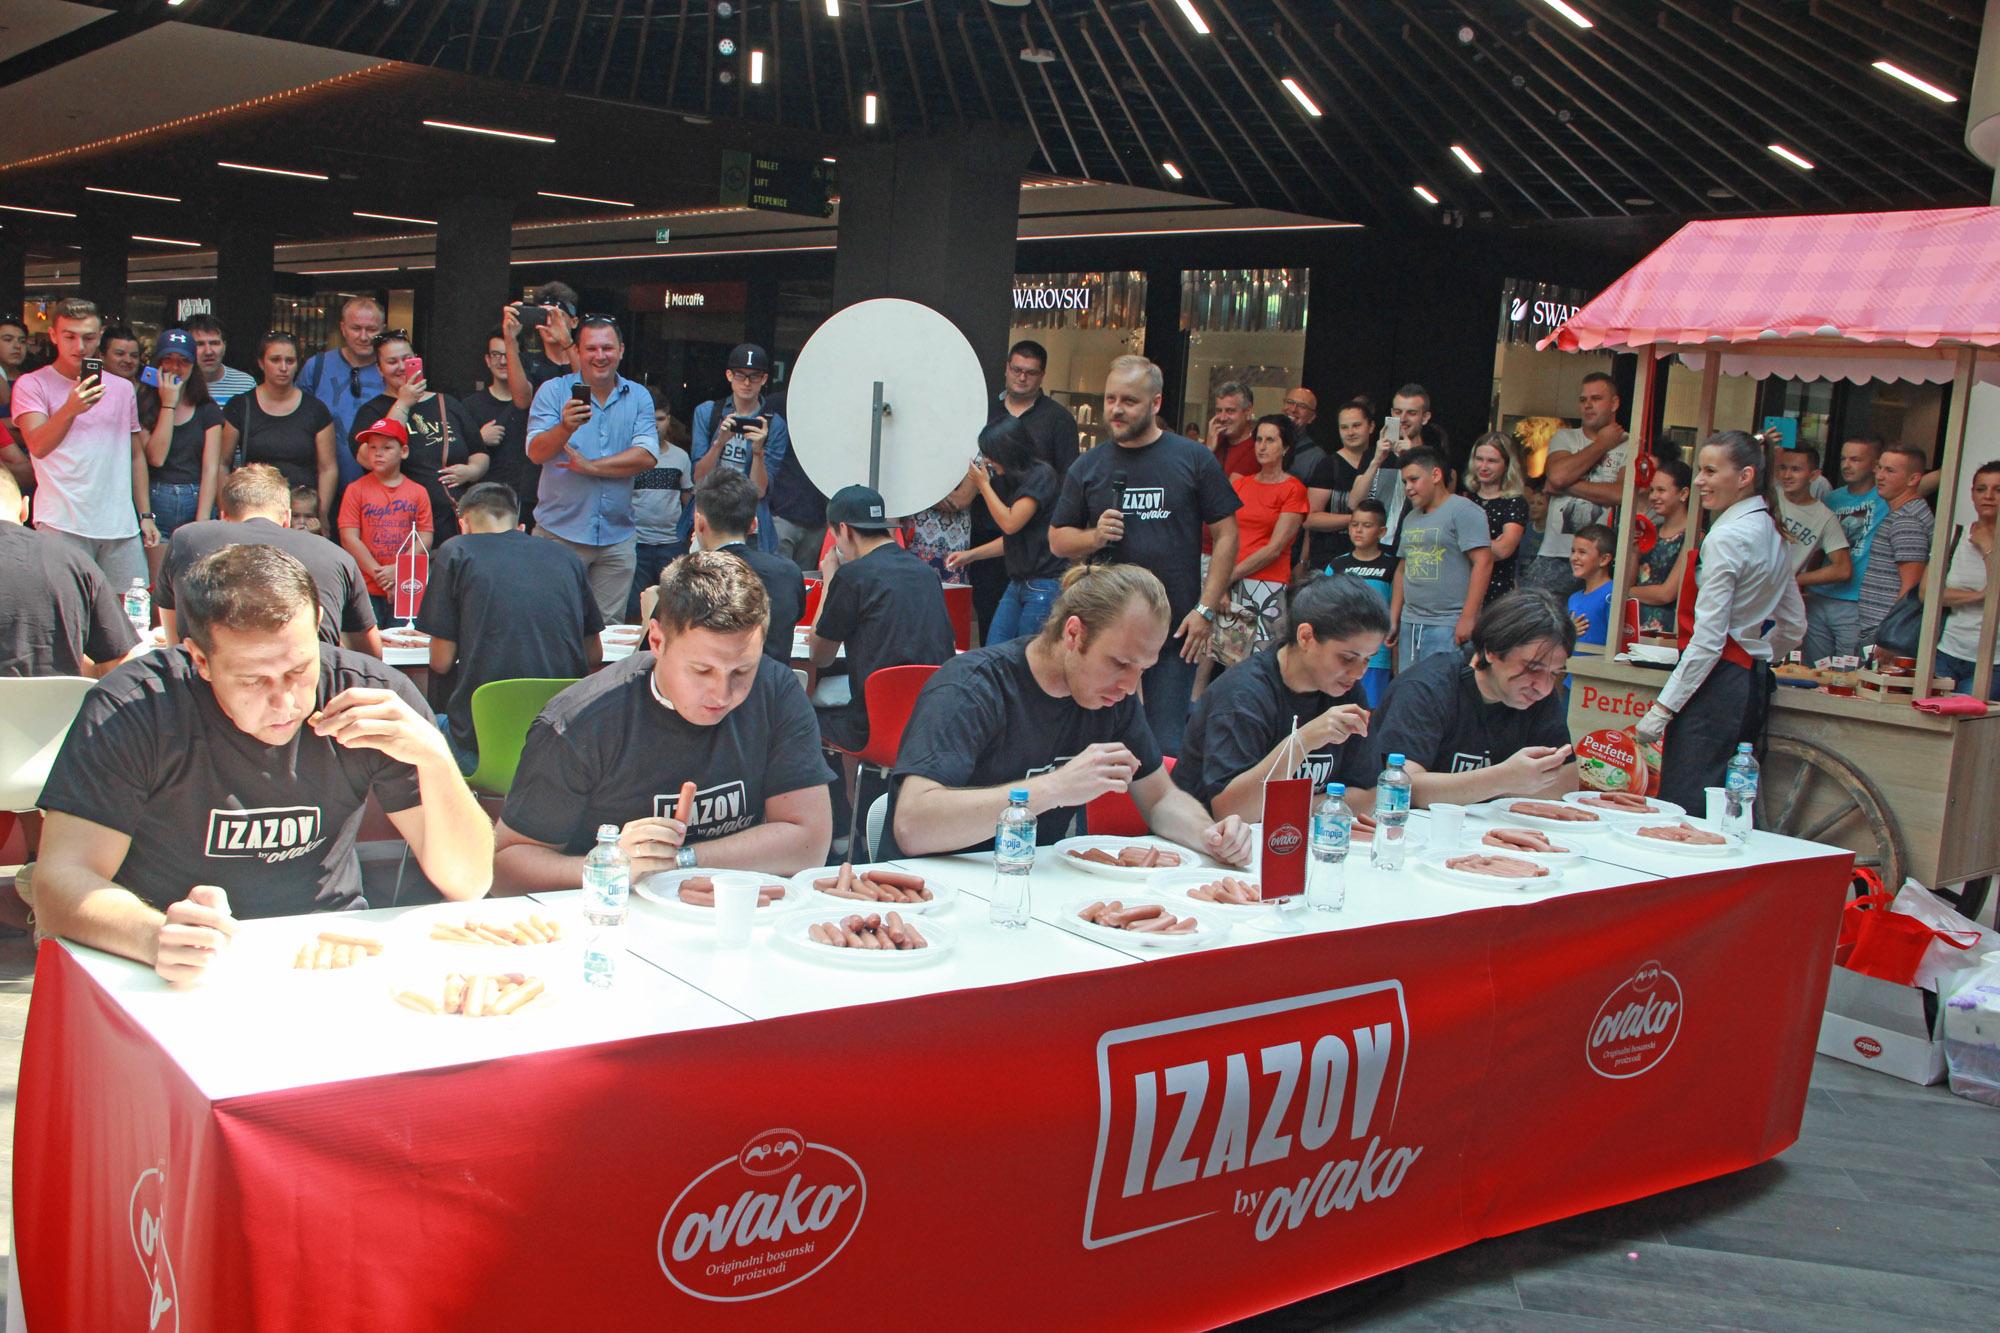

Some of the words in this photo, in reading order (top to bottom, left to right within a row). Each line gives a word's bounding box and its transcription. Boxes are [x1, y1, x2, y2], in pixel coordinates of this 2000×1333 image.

[754, 178, 768, 187] LIFT
[753, 195, 788, 208] STEPENICE
[672, 293, 705, 306] Marcaffe
[1013, 288, 1090, 309] WAROVSKI
[1141, 508, 1171, 520] ovako
[1583, 735, 1634, 765] Perfetta
[664, 791, 739, 827] IAZOV
[217, 816, 315, 850] IZAZOV
[1270, 833, 1299, 847] ovako
[267, 837, 327, 863] ovako
[1592, 991, 1678, 1048] ovako
[1121, 1021, 1392, 1199] IZAZOV
[1233, 1189, 1265, 1217] by
[1254, 1135, 1423, 1242] ovako
[672, 1173, 856, 1262] ovako
[705, 1252, 764, 1277] Originalni
[765, 1240, 816, 1263] bosanski
[732, 1261, 787, 1286] proizvodi
